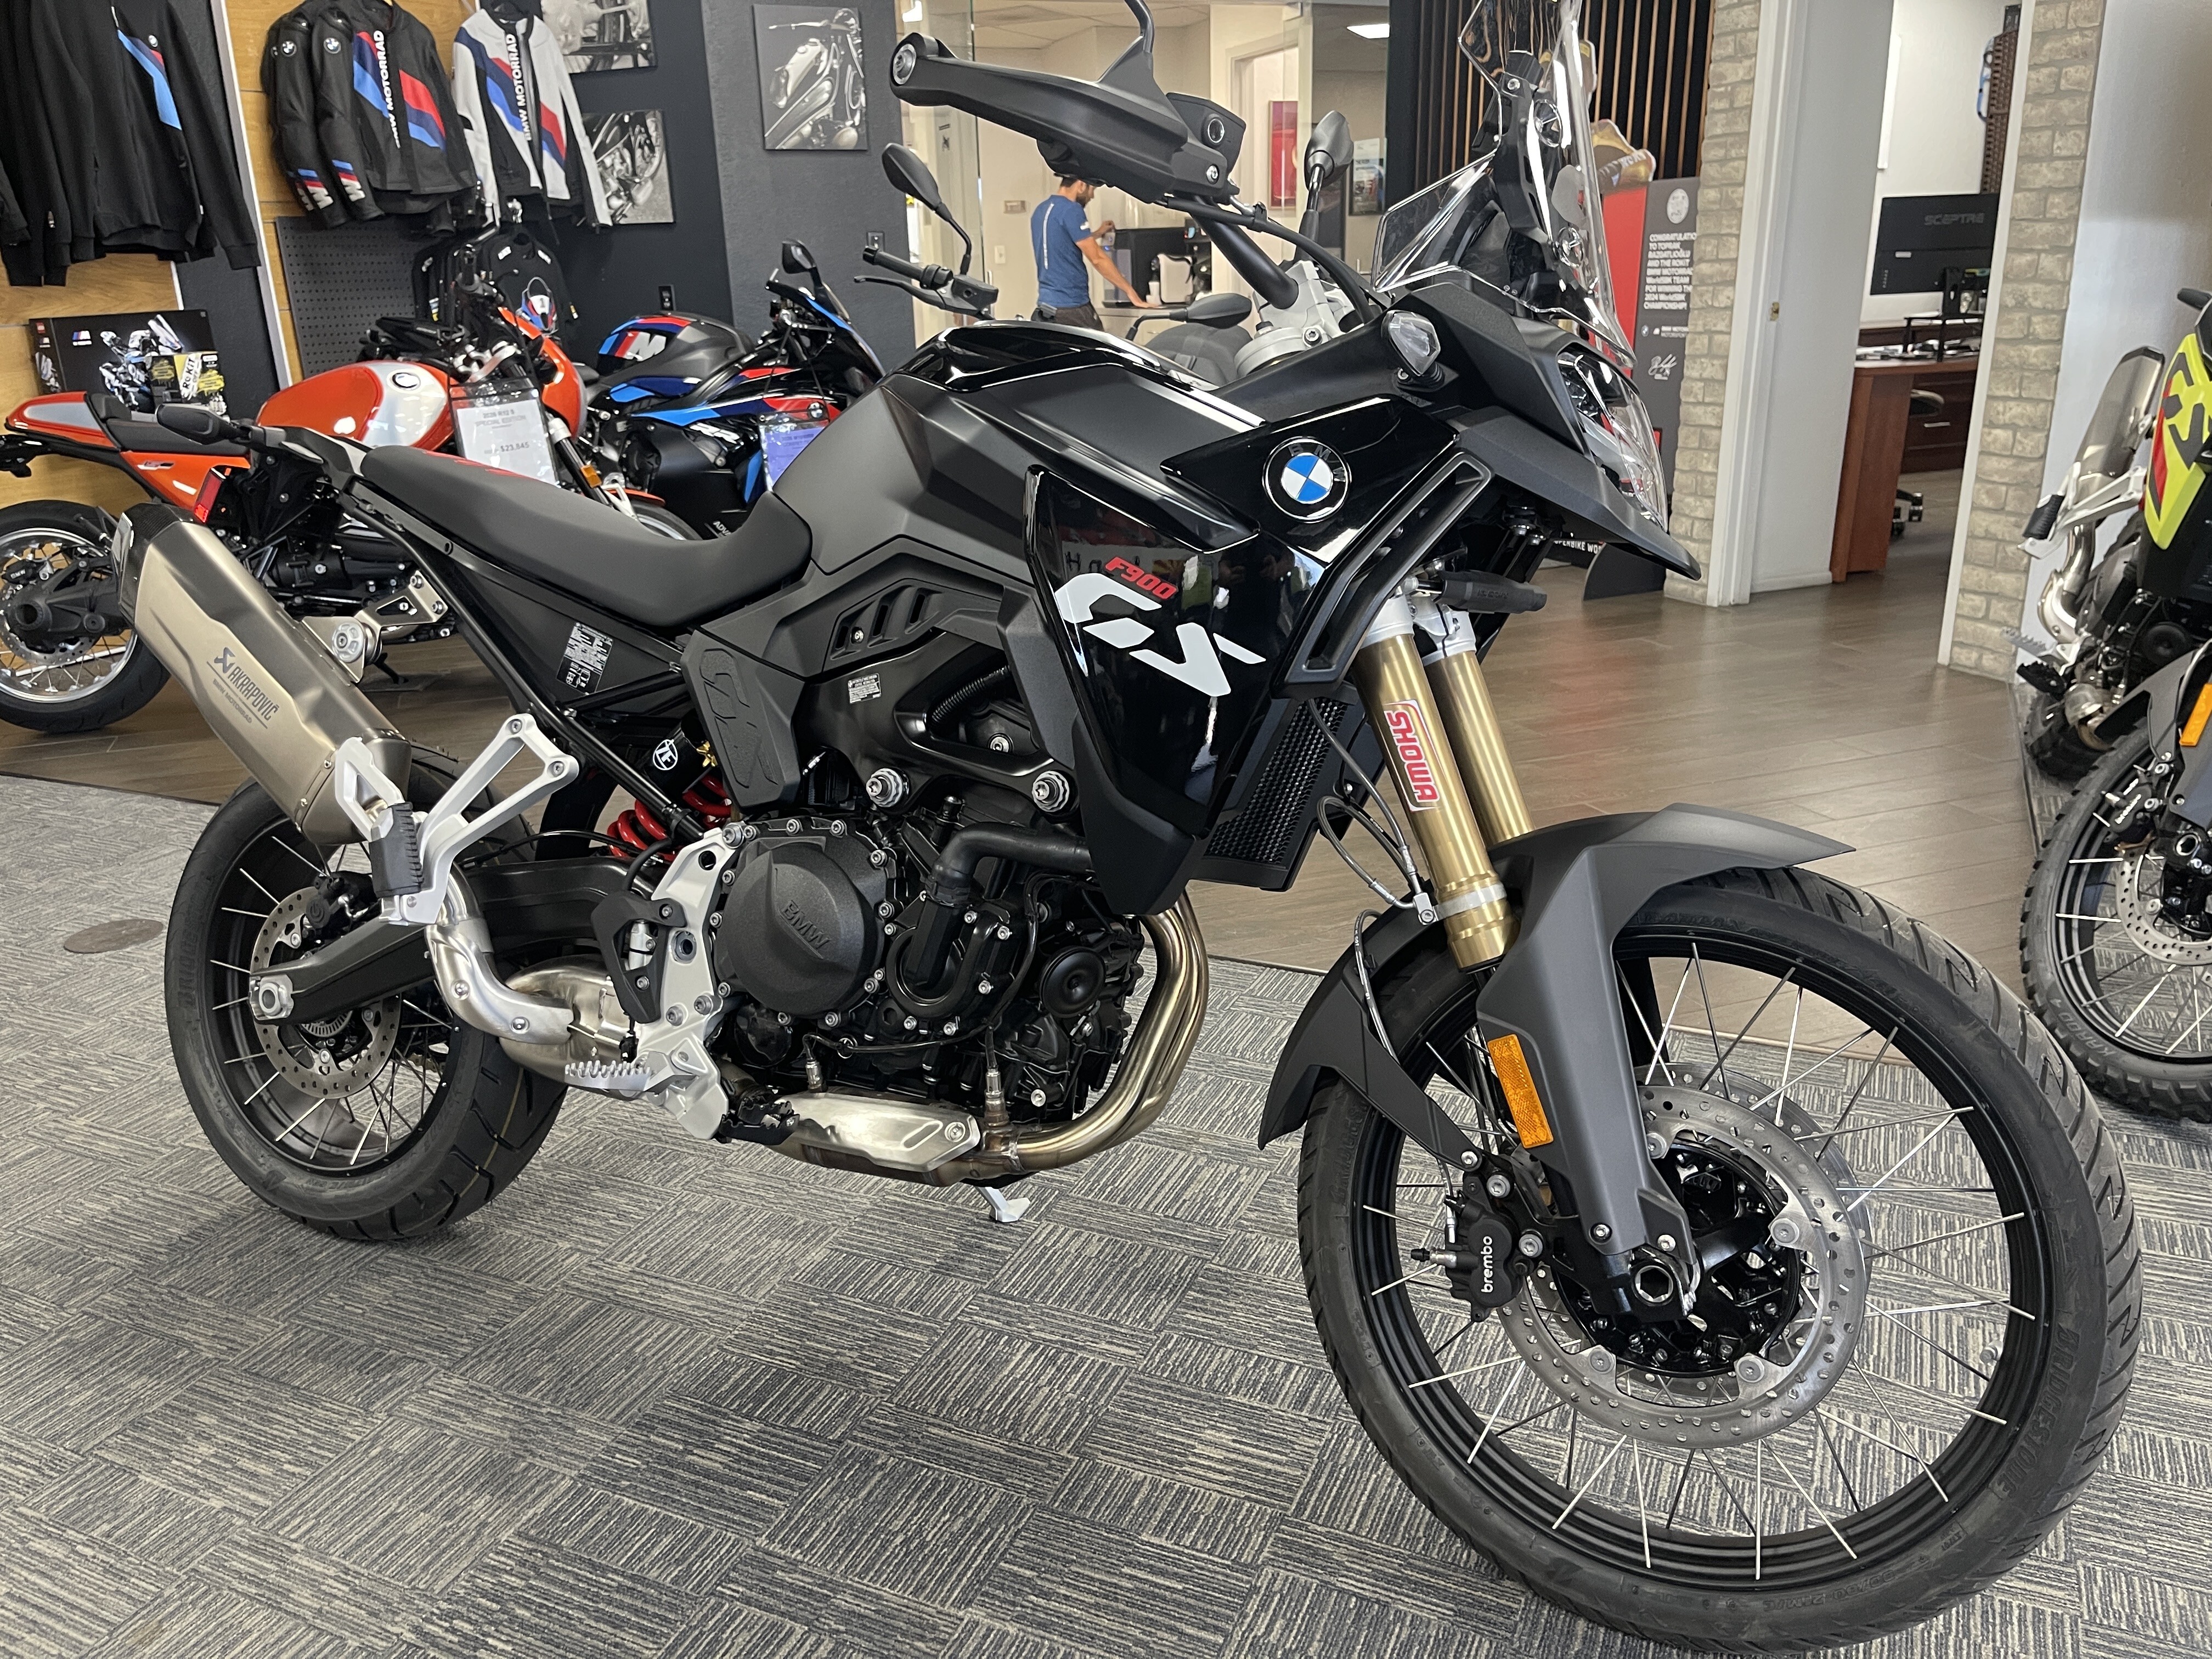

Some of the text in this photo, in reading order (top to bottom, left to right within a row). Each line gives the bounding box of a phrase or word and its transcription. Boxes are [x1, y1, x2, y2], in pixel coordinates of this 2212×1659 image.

[374, 30, 393, 111] MOTORRAD
[506, 33, 526, 106] MOTORRAD
[1105, 556, 1179, 600] F900
[227, 665, 280, 721] AKRAPOVIČ
[1384, 710, 1441, 803] SHOWA
[781, 900, 831, 951] BMW
[1481, 1235, 1493, 1293] brembo
[1997, 1324, 2080, 1493] BRIDGESTONE
